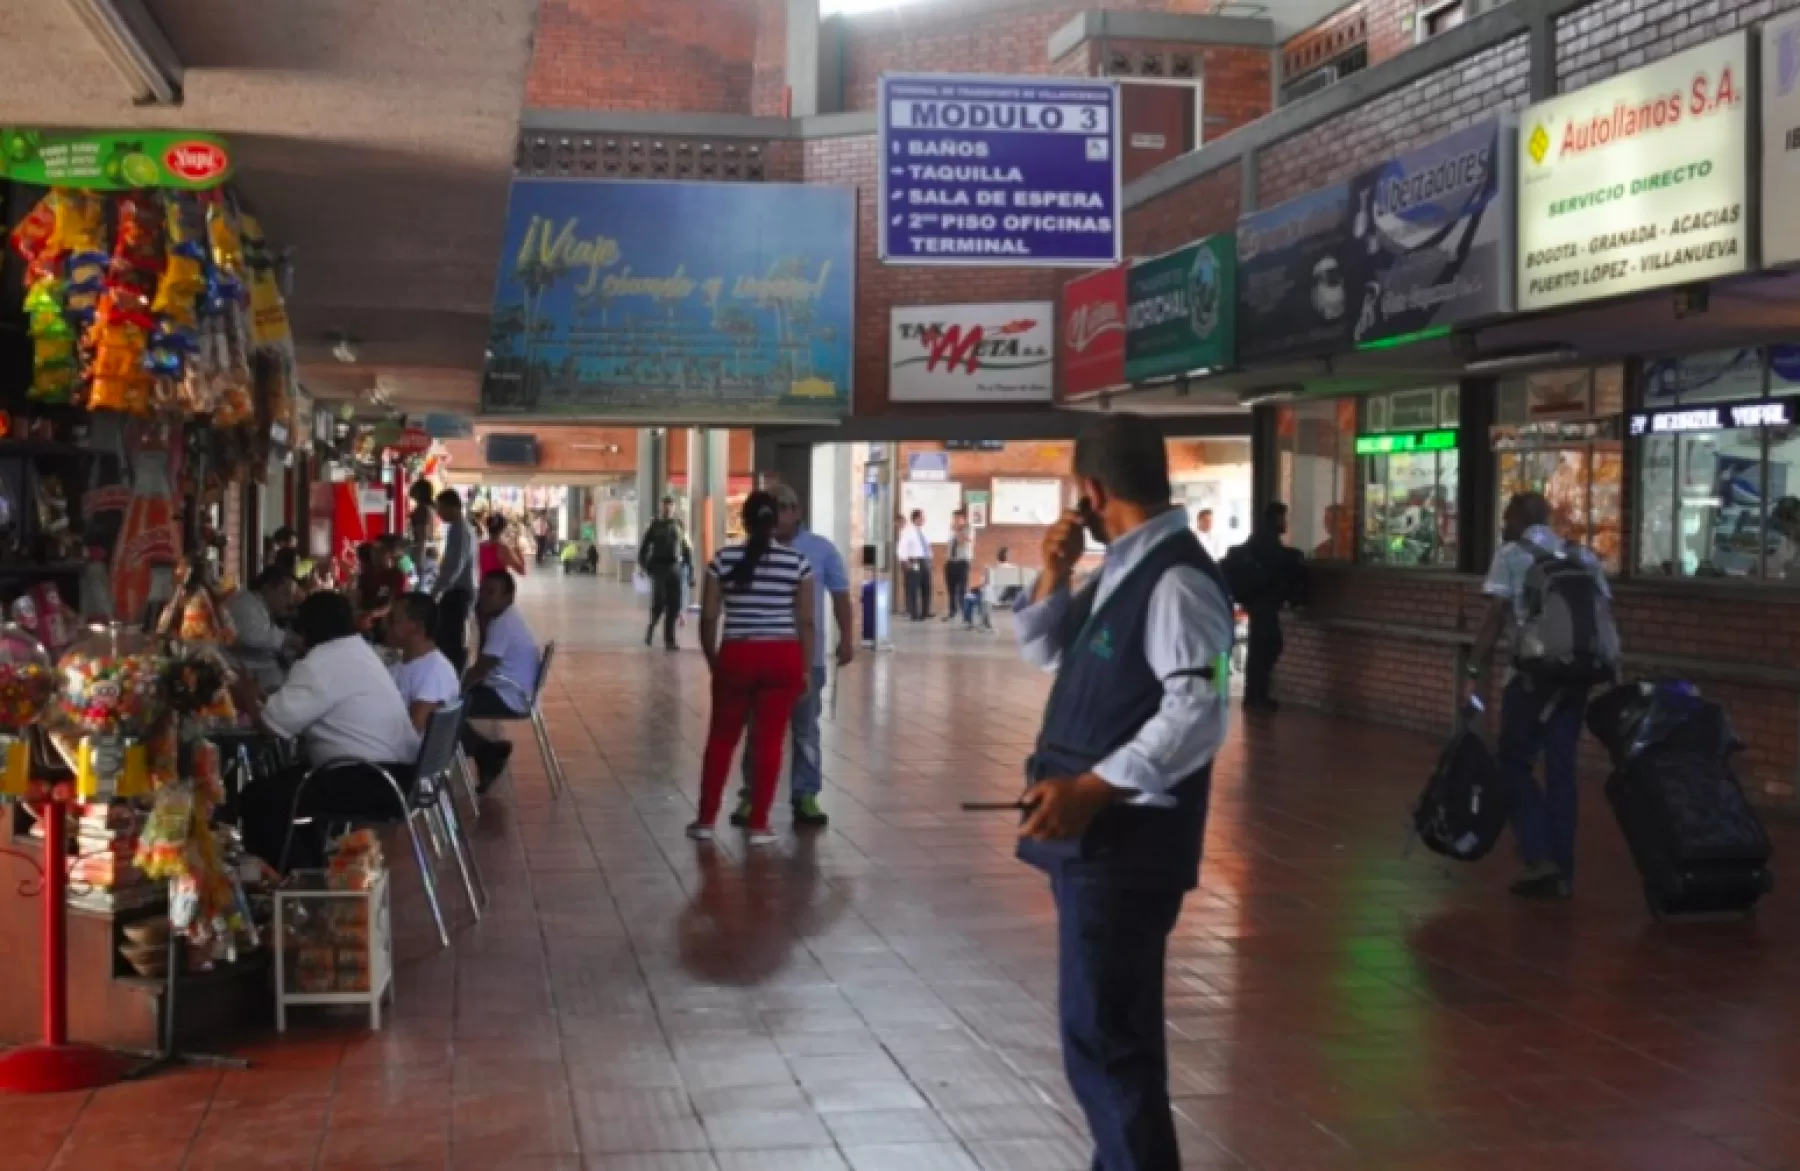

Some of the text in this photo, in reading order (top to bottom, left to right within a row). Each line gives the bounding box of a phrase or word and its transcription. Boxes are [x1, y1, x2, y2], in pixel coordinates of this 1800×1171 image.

[911, 103, 1098, 129] MODULO 3
[1559, 66, 1741, 156] Autollanos S.A.
[908, 139, 989, 157] BAÑOS
[908, 165, 1023, 182] TAQUILLA
[908, 190, 1103, 209] SALA DE ESPERA
[1548, 160, 1713, 217] SERVICIO DIRECTO
[942, 214, 996, 230] PISO
[1003, 215, 1111, 232] OFICINAS
[910, 237, 1030, 254] TERMINAL
[1525, 242, 1577, 269] BOGOTA
[1588, 223, 1657, 254] GRANADA
[1671, 203, 1740, 236] ACACIAS
[1529, 269, 1580, 295] PUERTO
[1583, 259, 1628, 285] LOPEZ
[1640, 237, 1738, 272] VILLANUEVA
